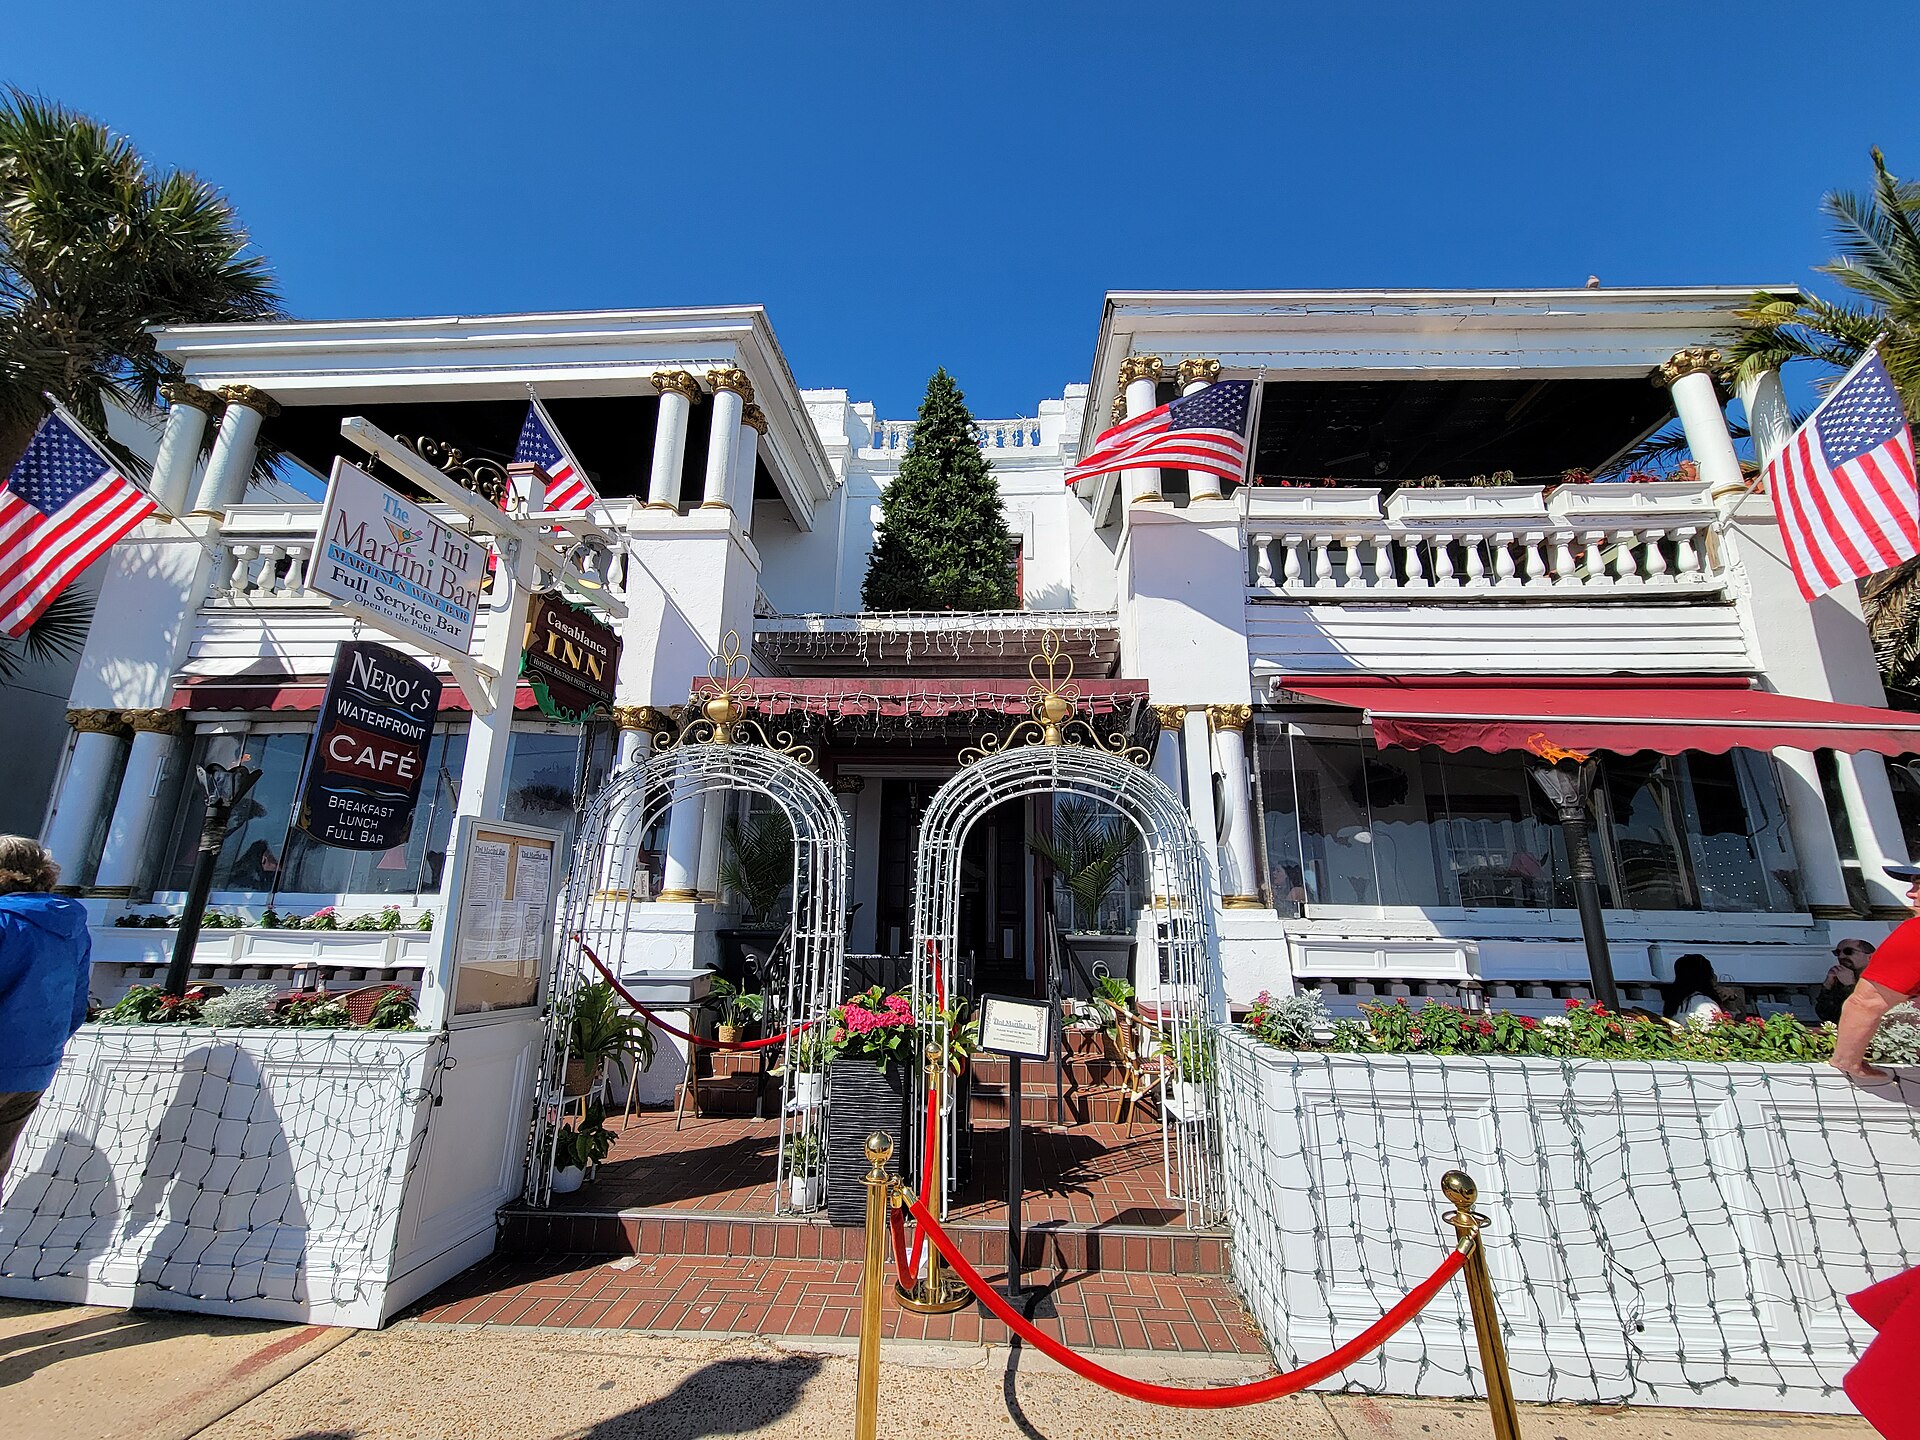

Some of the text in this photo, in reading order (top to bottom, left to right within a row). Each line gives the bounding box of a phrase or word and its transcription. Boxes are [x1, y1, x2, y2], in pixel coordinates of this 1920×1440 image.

[383, 493, 409, 523] The
[330, 509, 477, 611] Martini Bar
[427, 519, 470, 572] Tini
[330, 565, 462, 637] Full Service Bar
[332, 548, 468, 622] MARTINI & WINE BAR
[354, 594, 439, 637] Open to the Public
[547, 610, 607, 657] Casablanca
[544, 629, 607, 682] INN
[346, 650, 431, 712] NERO'S
[337, 698, 426, 740] WATERFRONT
[329, 734, 416, 779] CAFÉ
[328, 795, 395, 818] BREAKFAST
[339, 814, 379, 829] LUNCH
[325, 825, 385, 845] FULL BAR
